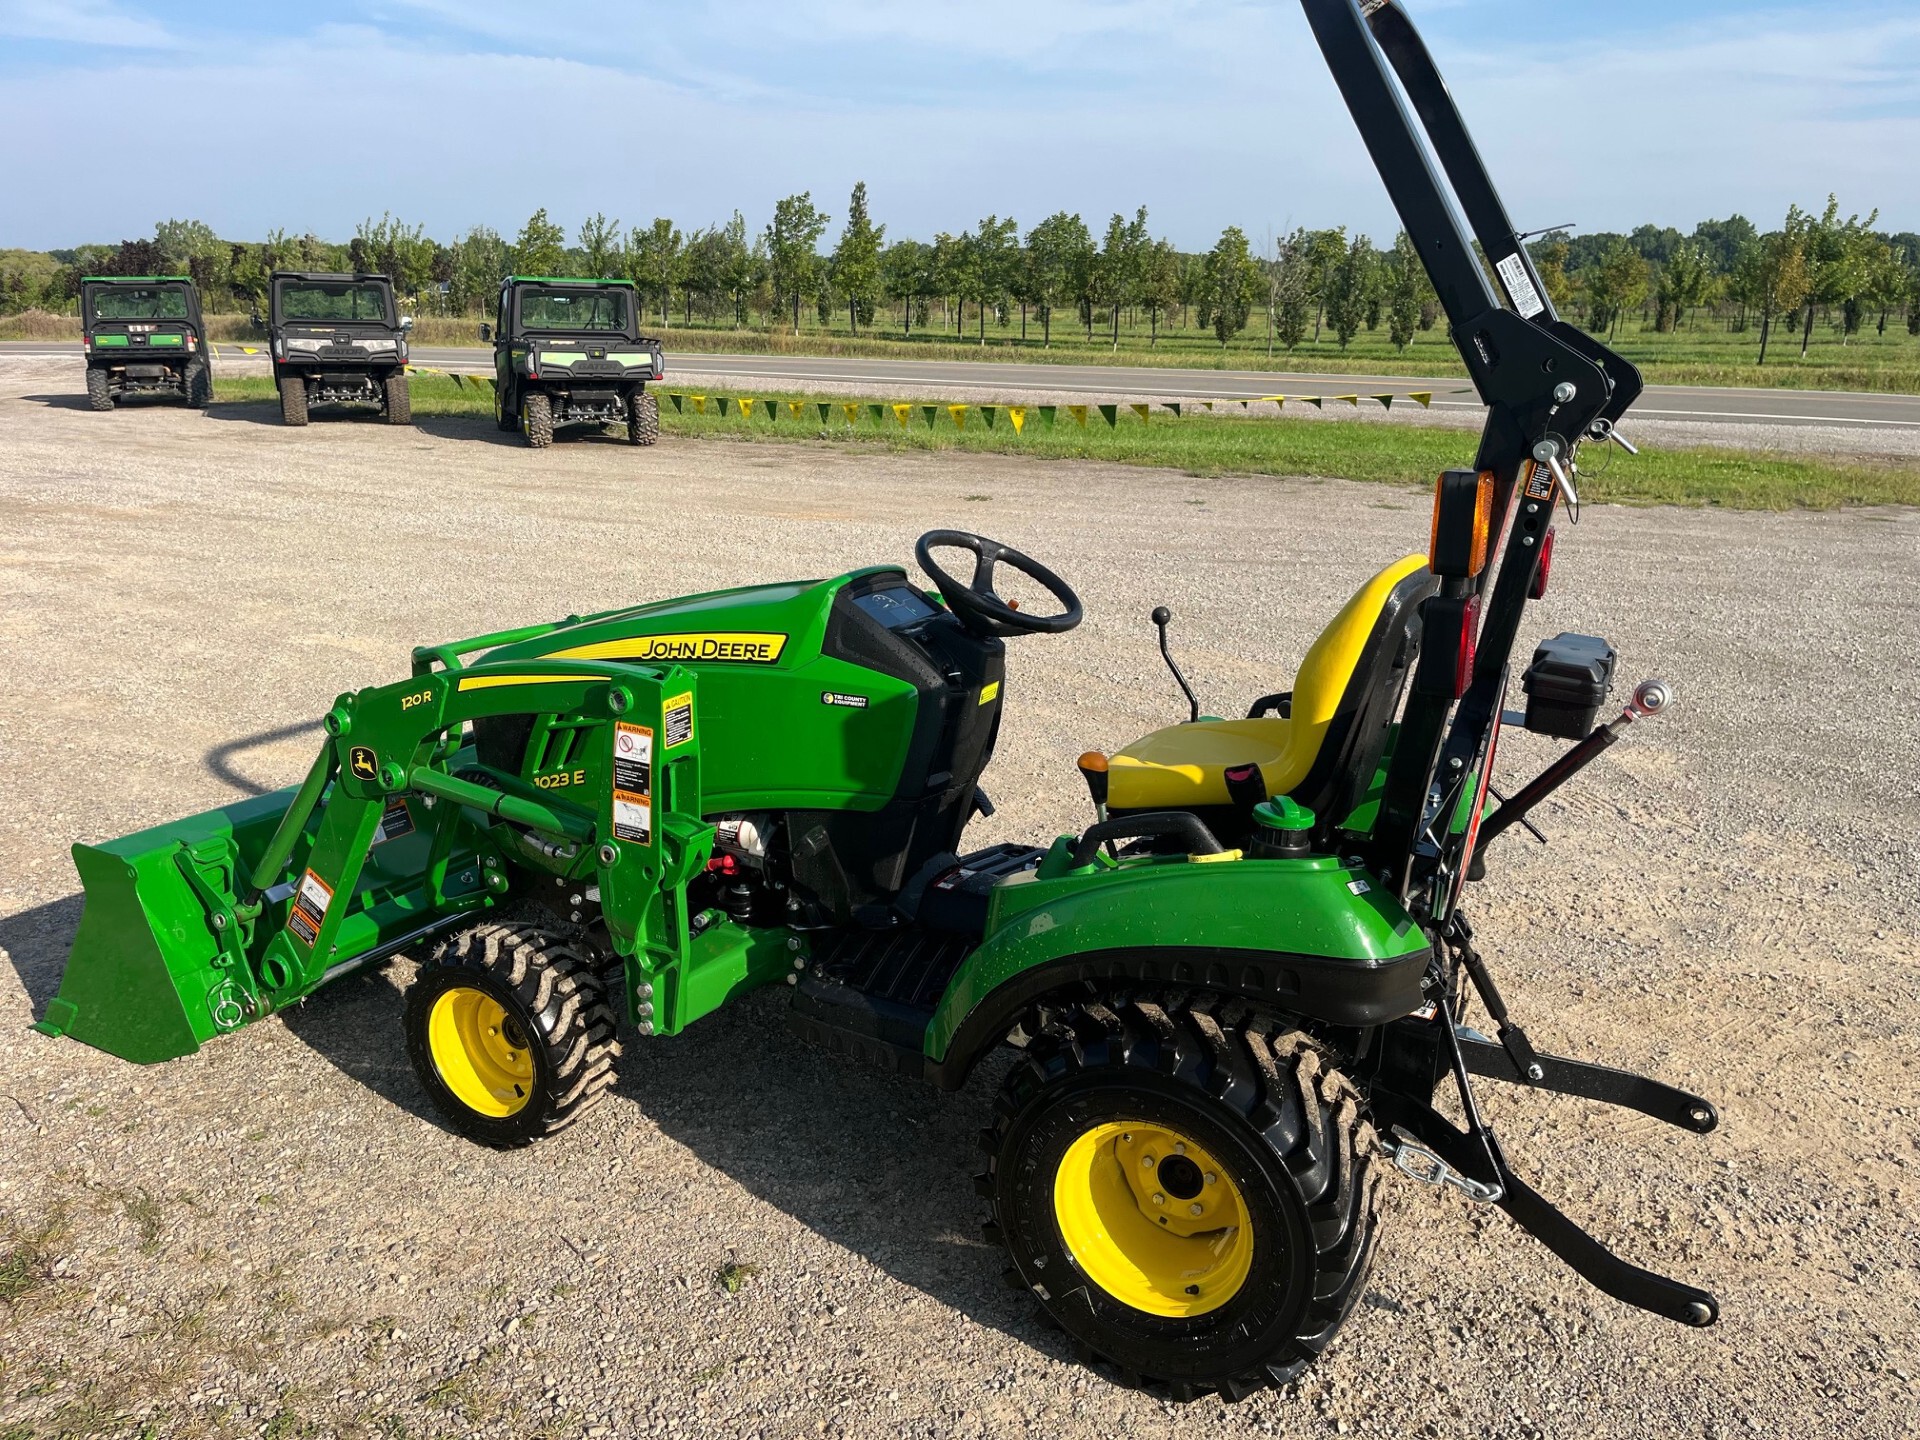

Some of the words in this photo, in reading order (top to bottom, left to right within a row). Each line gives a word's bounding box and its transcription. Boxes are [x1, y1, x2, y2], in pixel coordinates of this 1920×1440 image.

[642, 639, 697, 659] JOHN
[701, 639, 771, 660] DEERE
[401, 693, 422, 711] 120
[423, 690, 432, 703] R
[834, 699, 866, 707] EQUIPMENT
[622, 725, 652, 736] WARNING
[533, 772, 570, 789] 1023
[573, 769, 585, 785] E
[620, 793, 650, 806] WARNING
